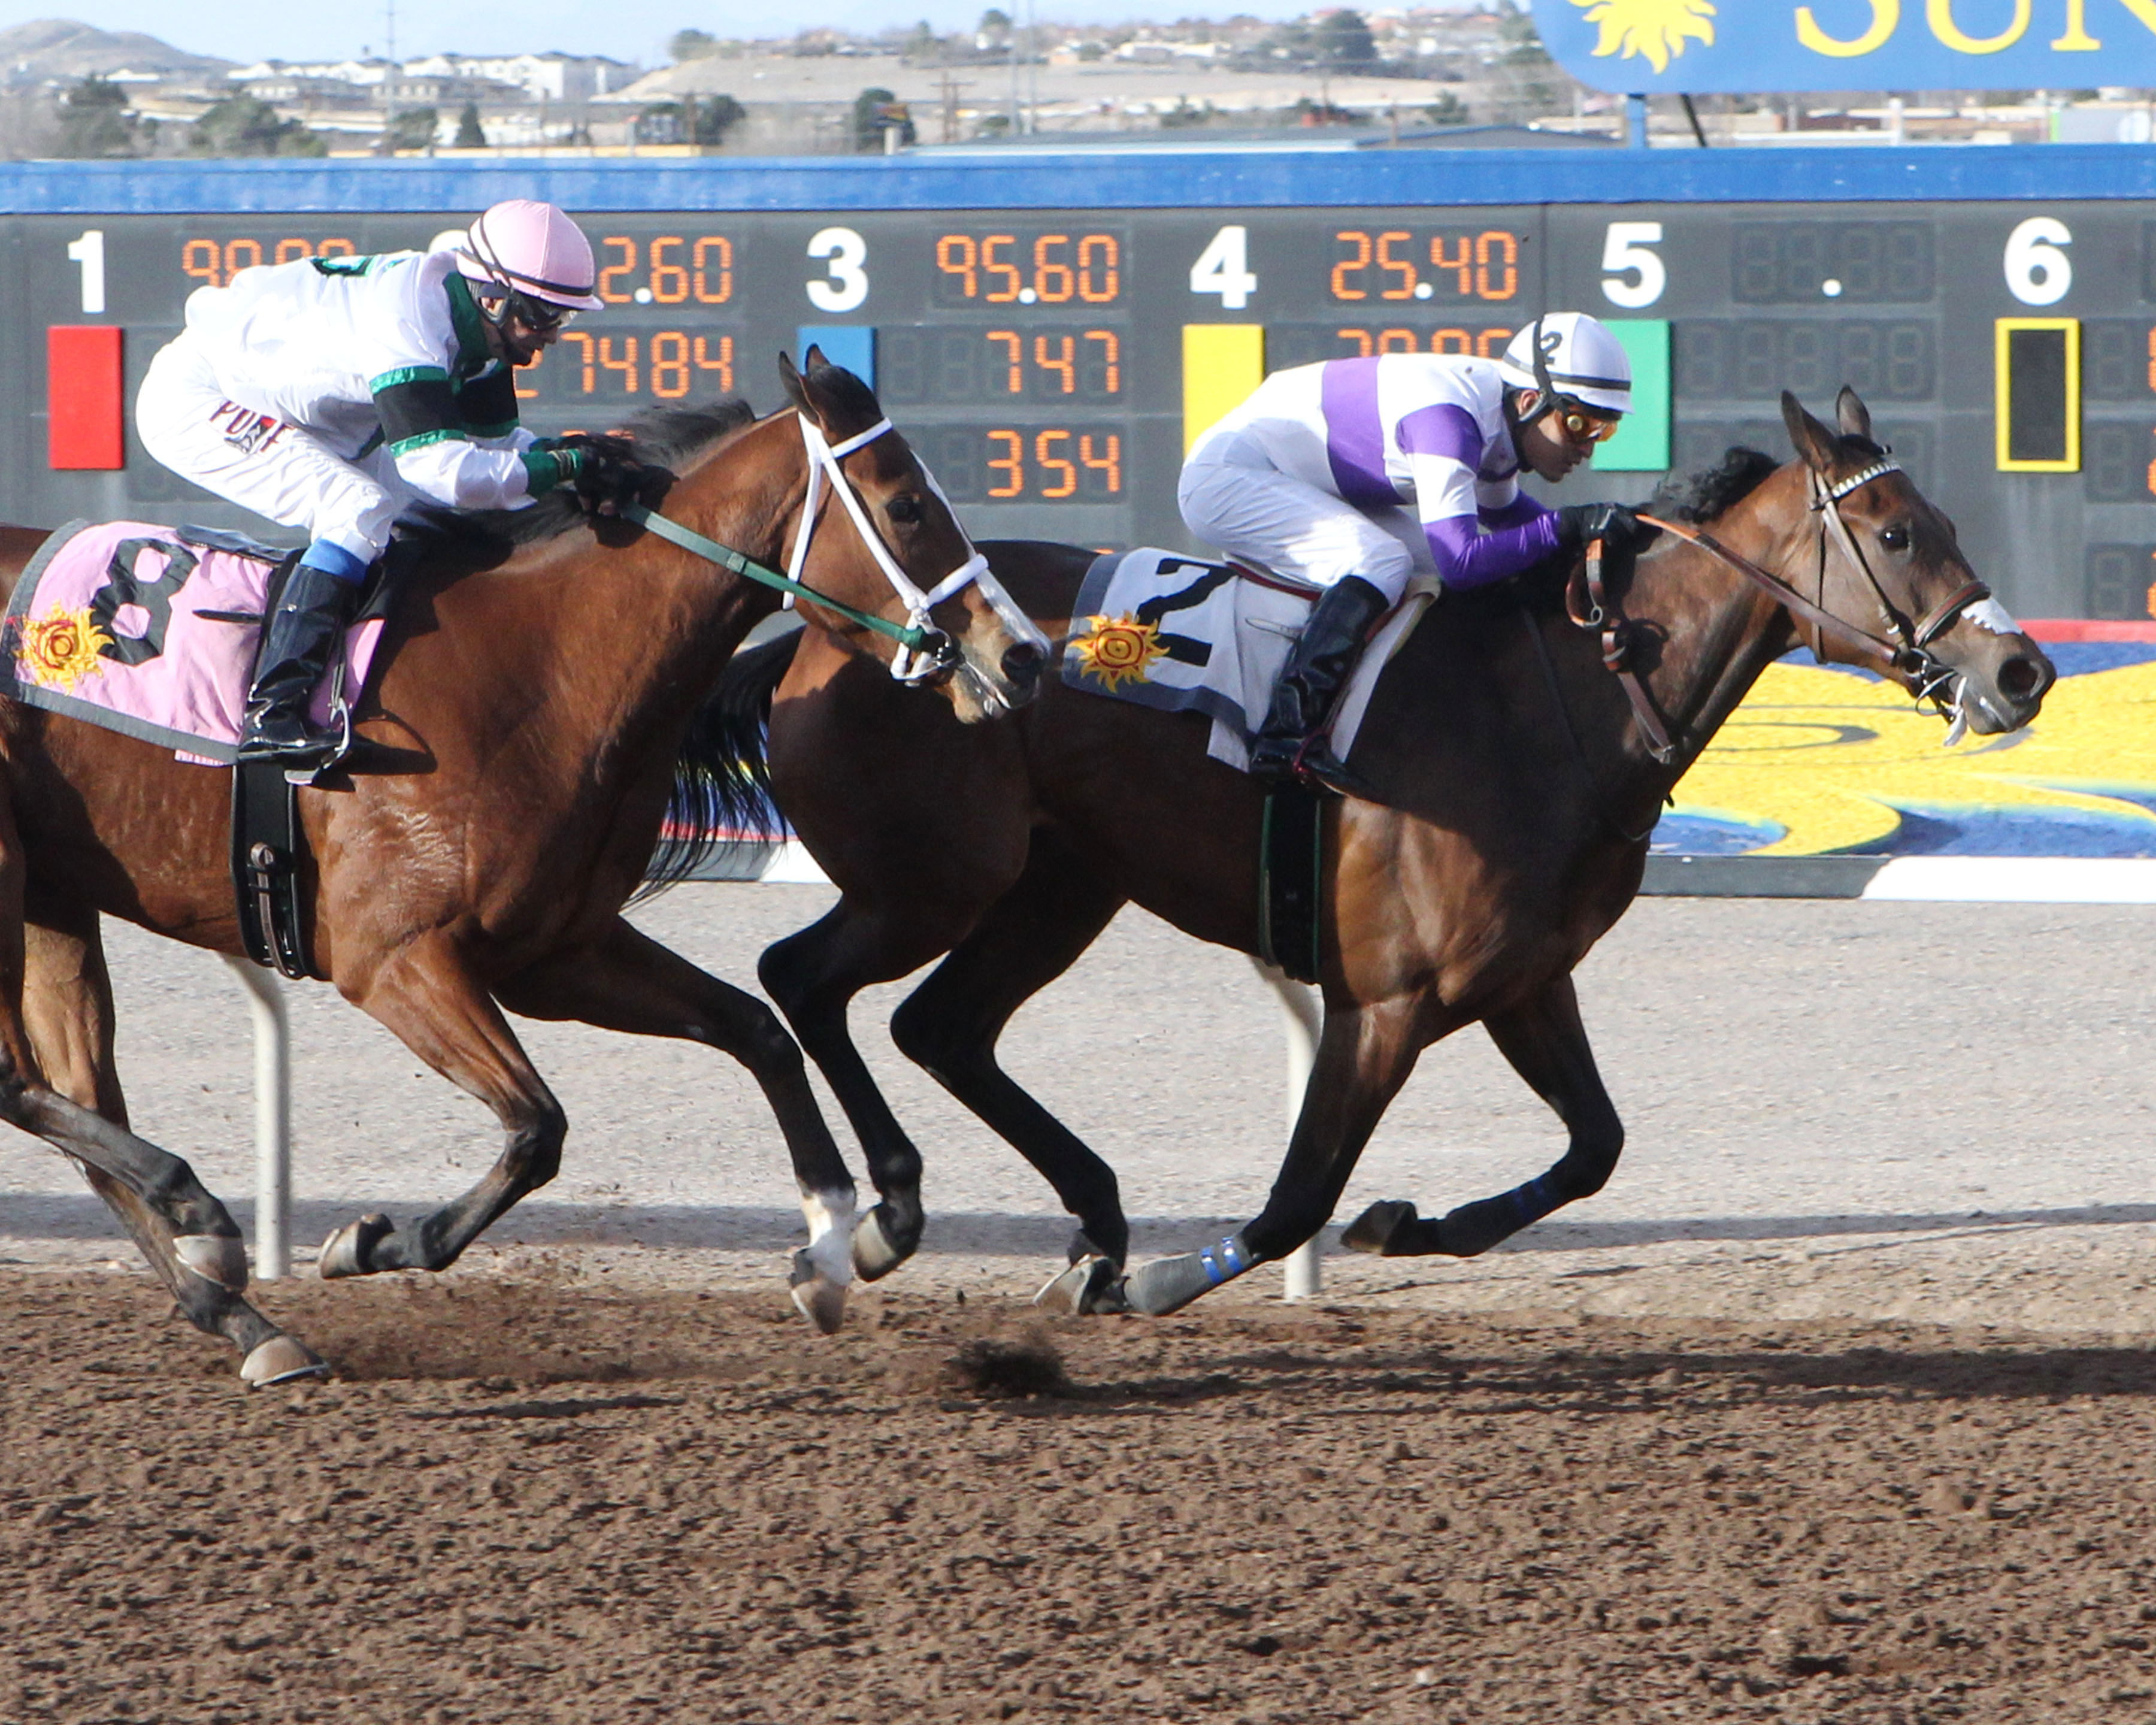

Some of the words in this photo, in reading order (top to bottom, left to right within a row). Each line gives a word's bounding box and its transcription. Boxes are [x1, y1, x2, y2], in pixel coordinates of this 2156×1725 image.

[68, 231, 104, 313] 1
[806, 227, 868, 312] 3
[936, 235, 1119, 303] 95.60
[1190, 226, 1256, 308] 4
[1331, 231, 1518, 301] 25.40
[1601, 222, 1666, 308] 5
[2004, 217, 2072, 305] 6
[986, 330, 1120, 394] 747
[1539, 331, 1563, 365] 2
[986, 429, 1121, 498] 354
[88, 538, 200, 668] 8
[1137, 558, 1240, 667] 2
